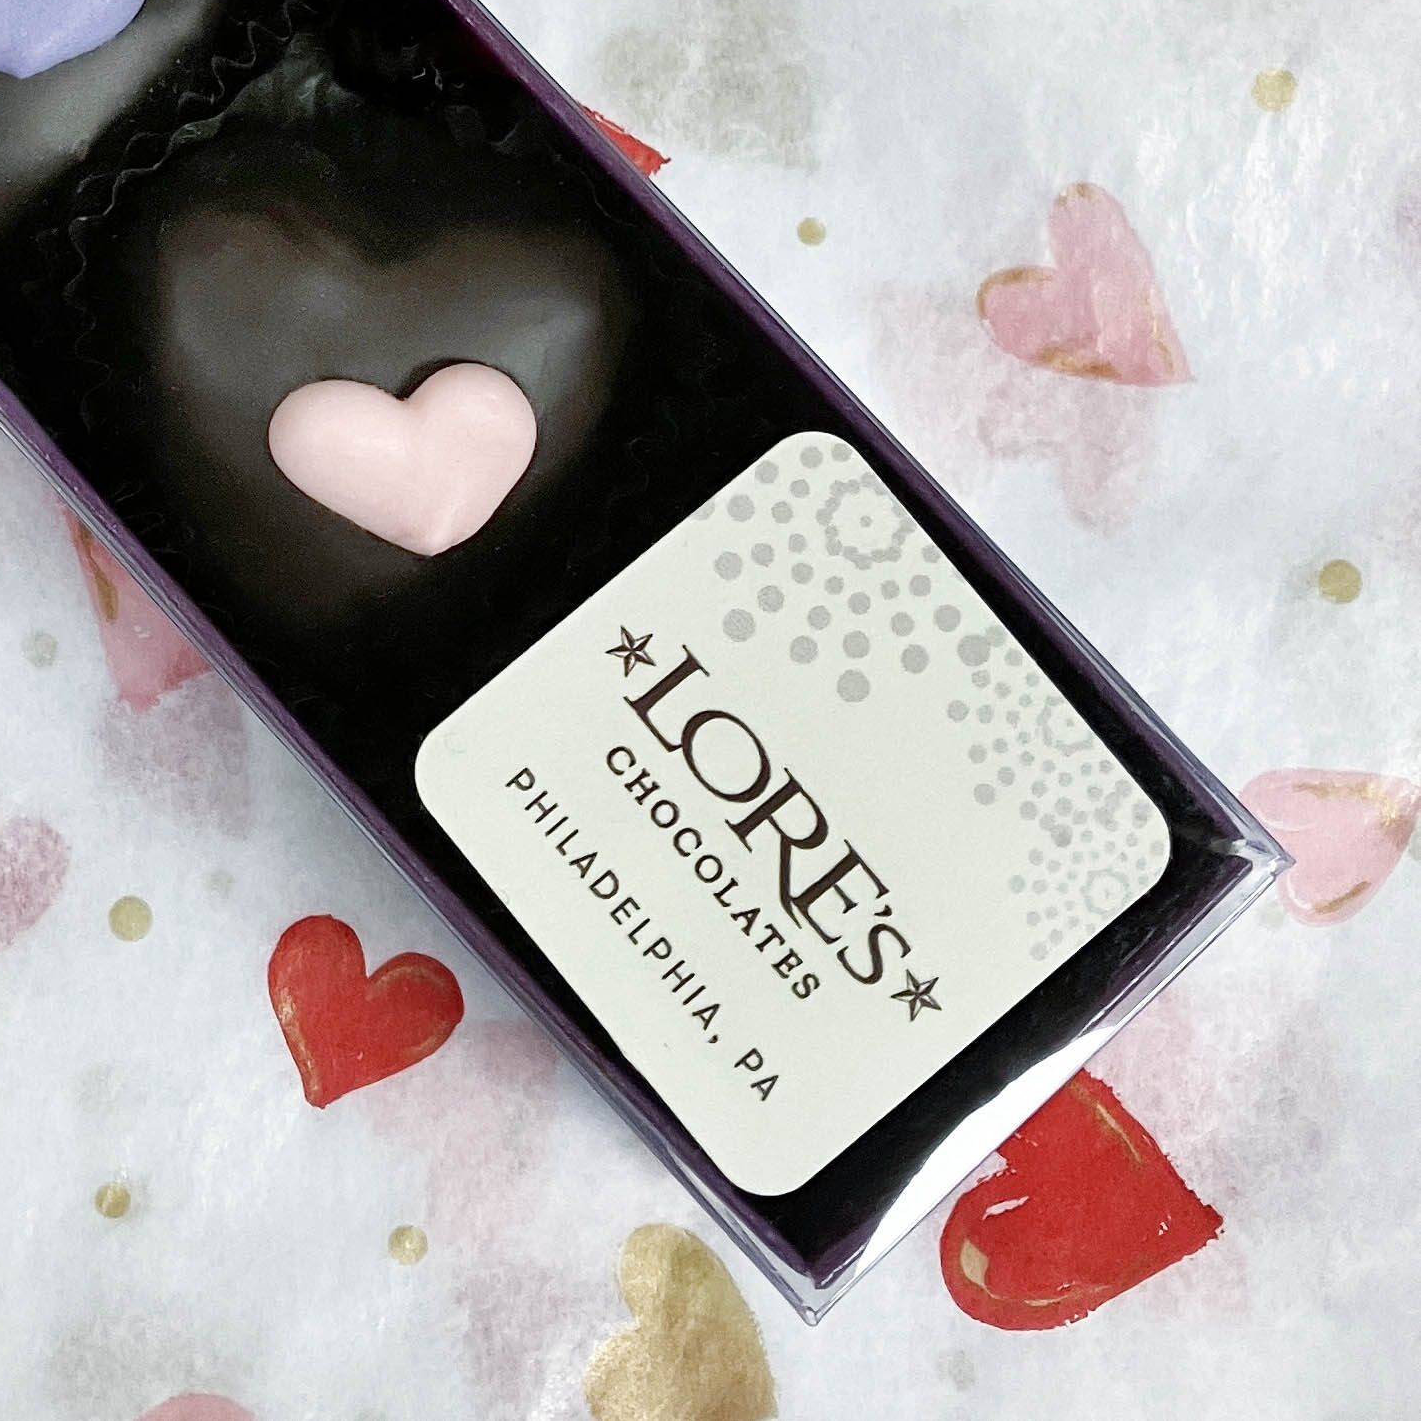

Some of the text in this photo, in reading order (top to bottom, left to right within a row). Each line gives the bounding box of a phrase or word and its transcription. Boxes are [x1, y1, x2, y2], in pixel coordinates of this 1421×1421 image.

[505, 767, 779, 1102] PHILADELPHIA, PA
[606, 745, 821, 1000] CHOCOLATES
[622, 644, 912, 985] LORE'S
